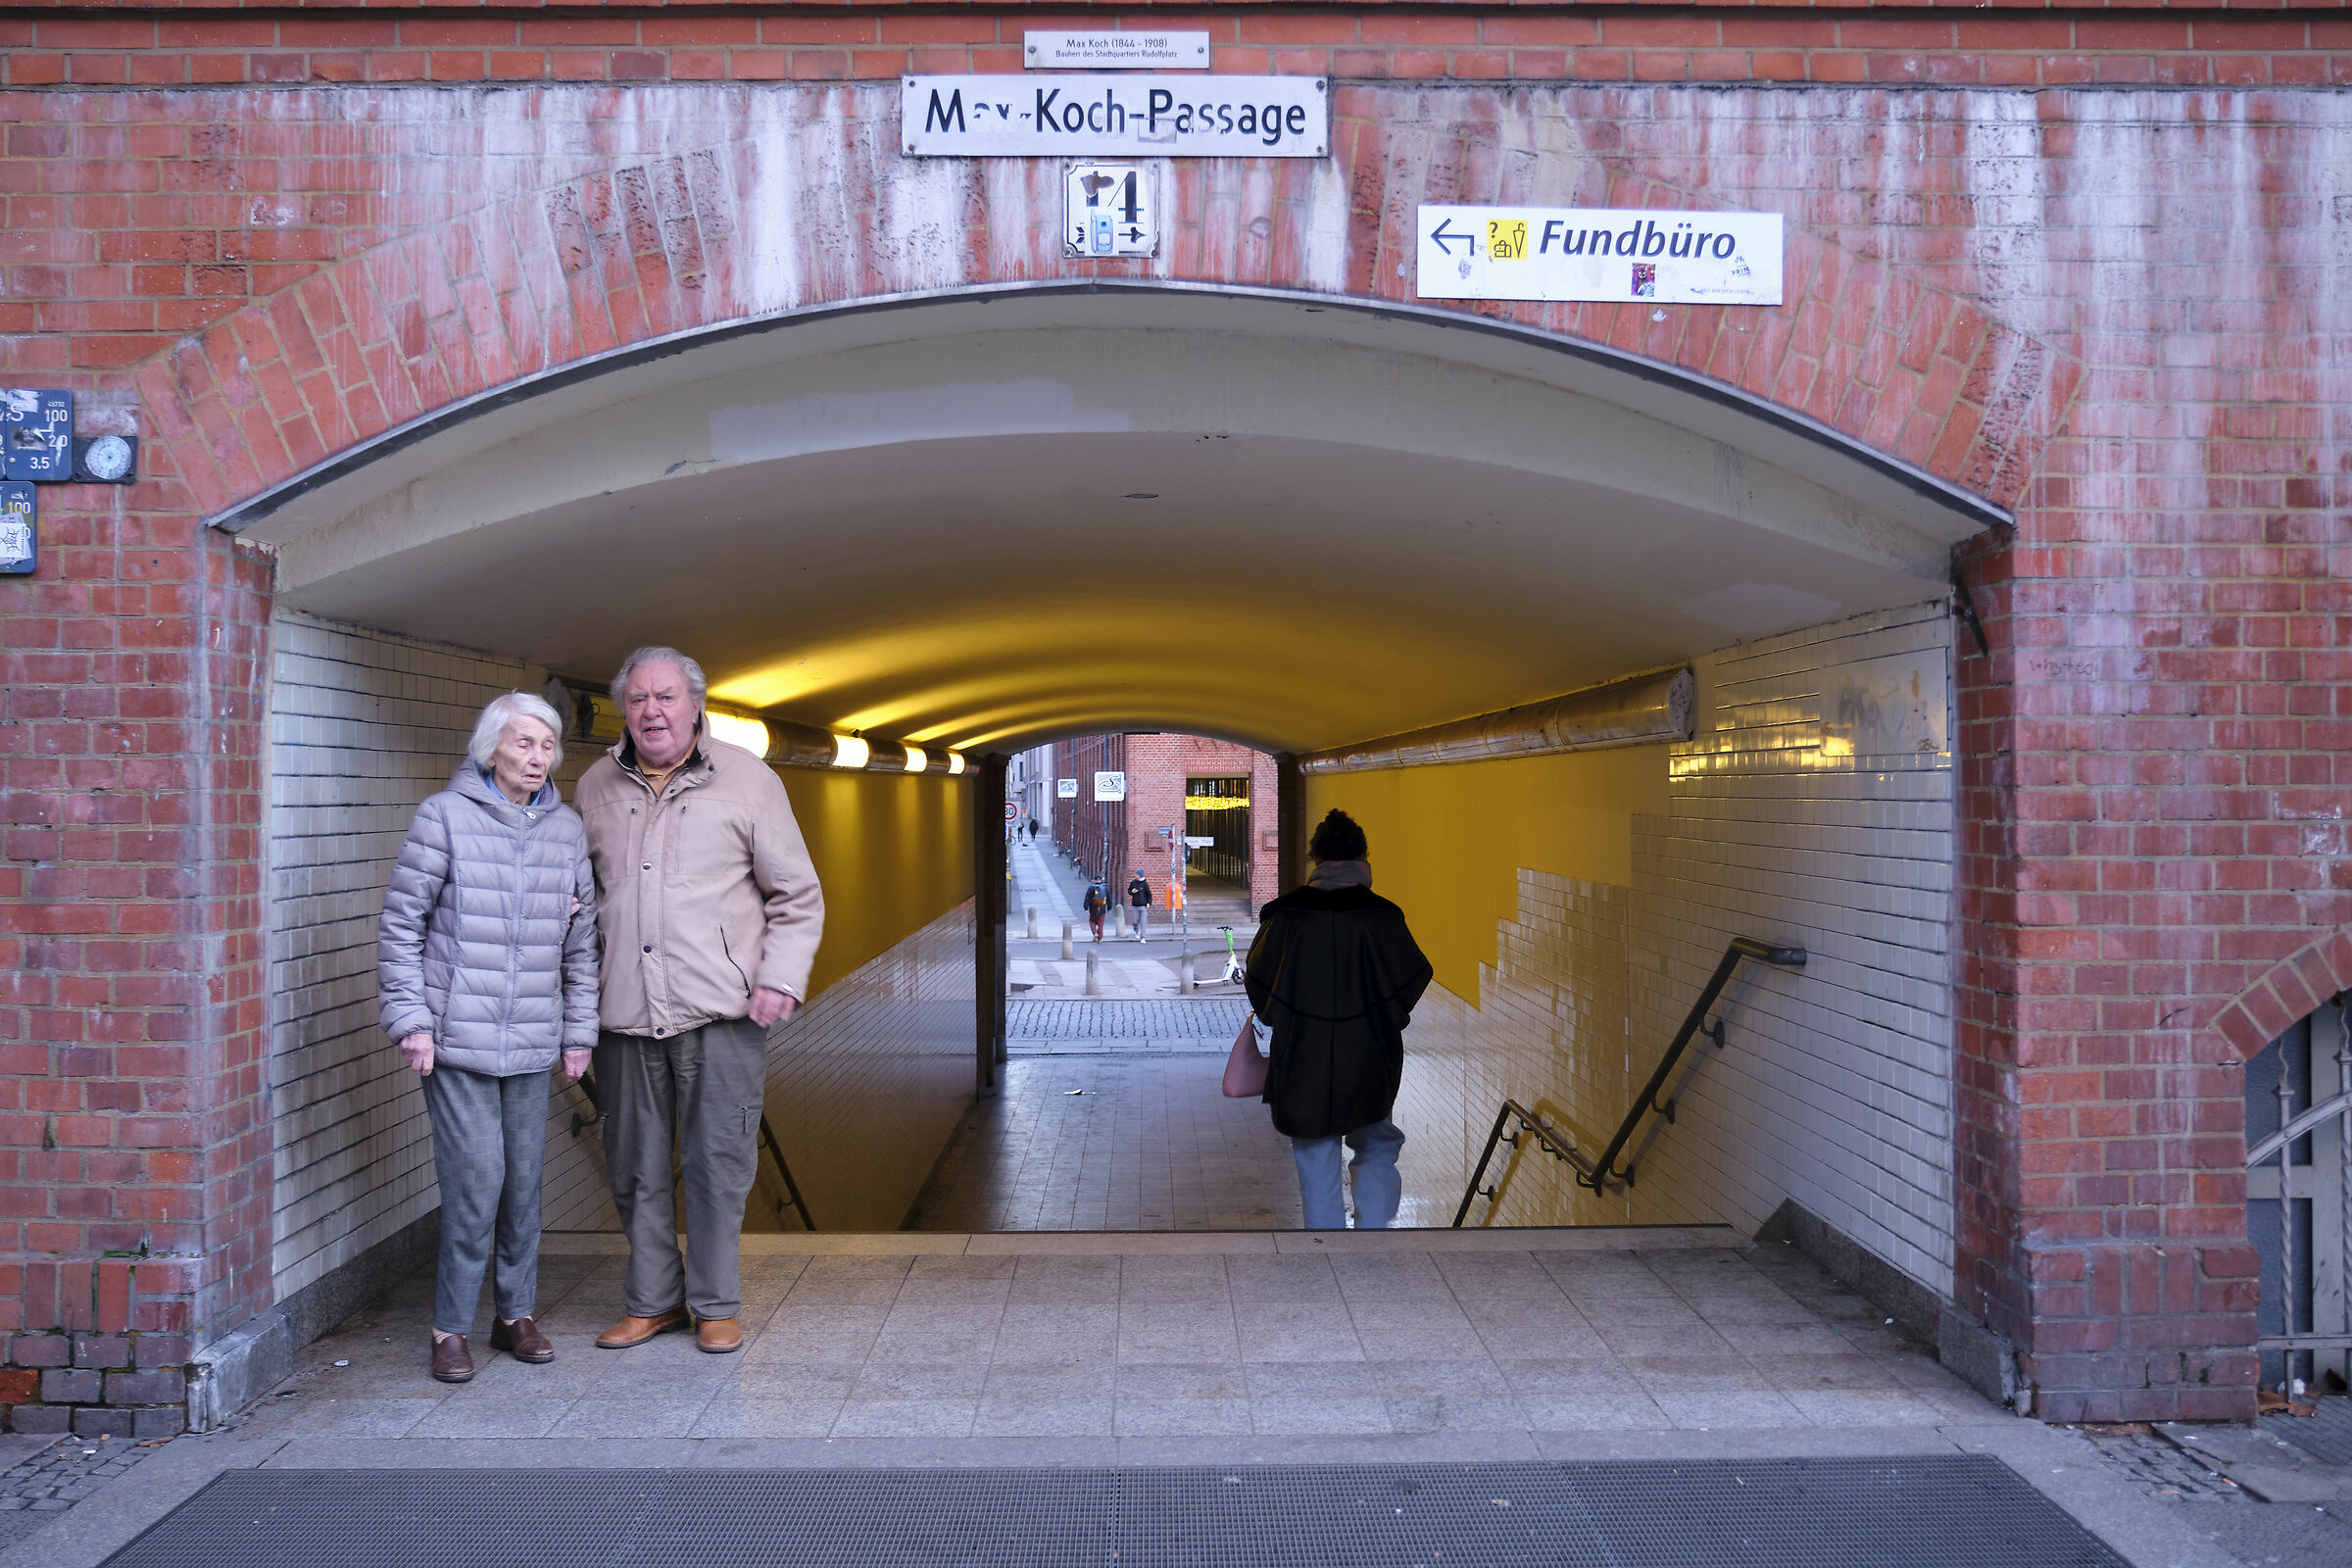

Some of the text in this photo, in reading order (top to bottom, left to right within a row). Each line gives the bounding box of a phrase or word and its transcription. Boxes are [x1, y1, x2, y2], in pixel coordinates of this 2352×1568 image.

[1066, 38, 1085, 48] Max
[1088, 38, 1108, 48] Koch
[1111, 38, 1135, 49] (1844
[1145, 38, 1168, 49] 1908)
[1055, 49, 1080, 58] Bauherr
[1095, 49, 1140, 59] Stadtquartiers
[1142, 49, 1177, 59] Rudolfplatz
[1539, 220, 1736, 260] Fundbüro
[44, 409, 69, 422] 100
[29, 457, 51, 470] 3,5
[8, 501, 30, 514] 100
